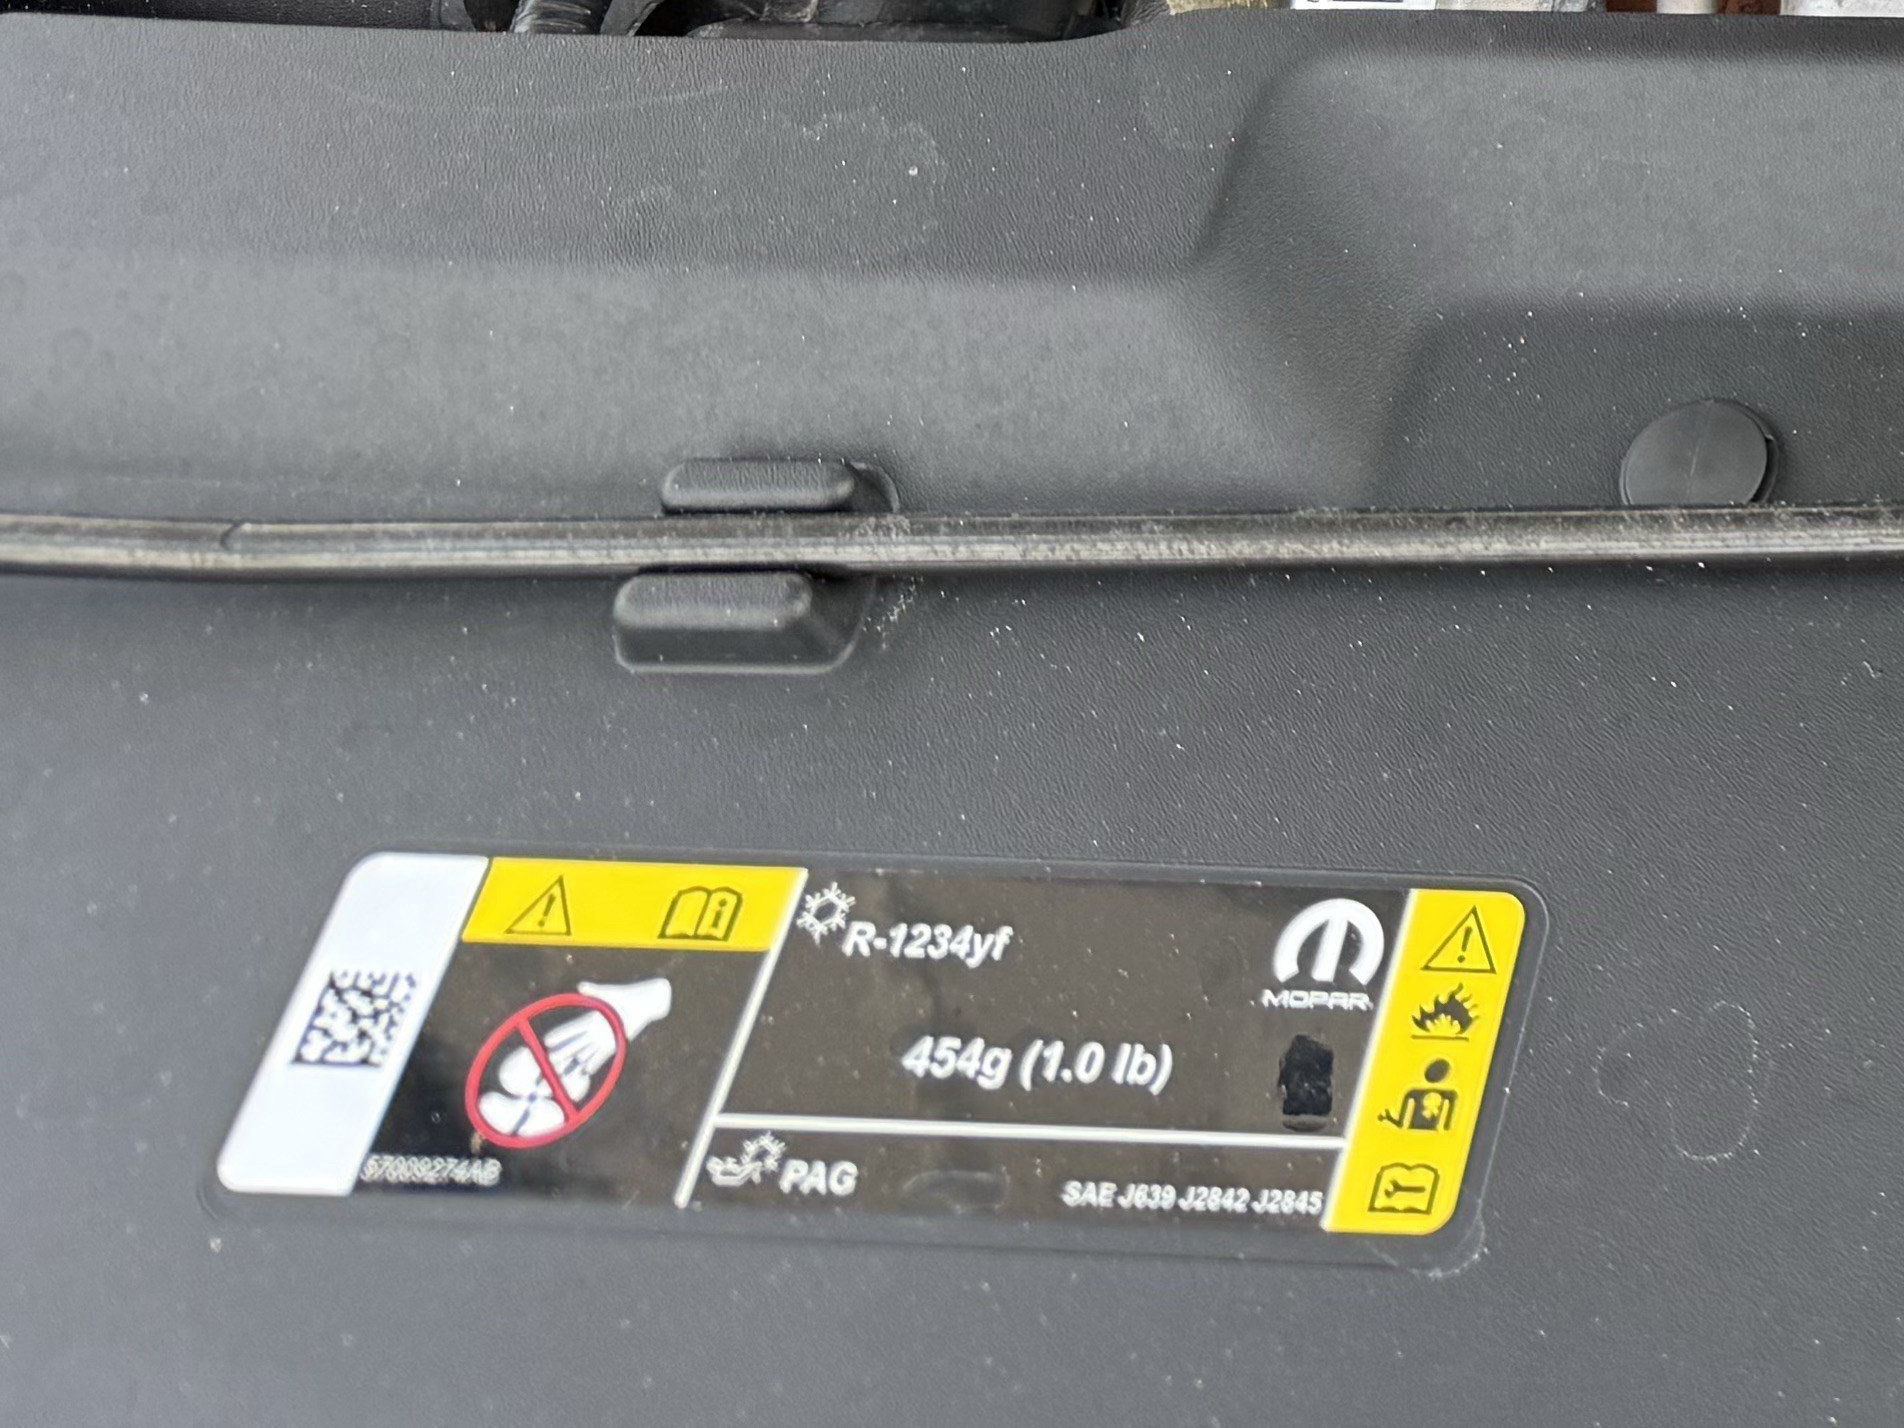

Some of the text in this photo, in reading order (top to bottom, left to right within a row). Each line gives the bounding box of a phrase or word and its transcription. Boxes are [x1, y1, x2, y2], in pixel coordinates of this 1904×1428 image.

[843, 921, 1015, 970] R-1234yf
[1261, 988, 1374, 1011] MOPAR
[903, 1036, 1174, 1095] 454g (1.0 lb)
[778, 1159, 858, 1196] PAG
[1061, 1180, 1323, 1215] SAE J639 J2842 J2845
